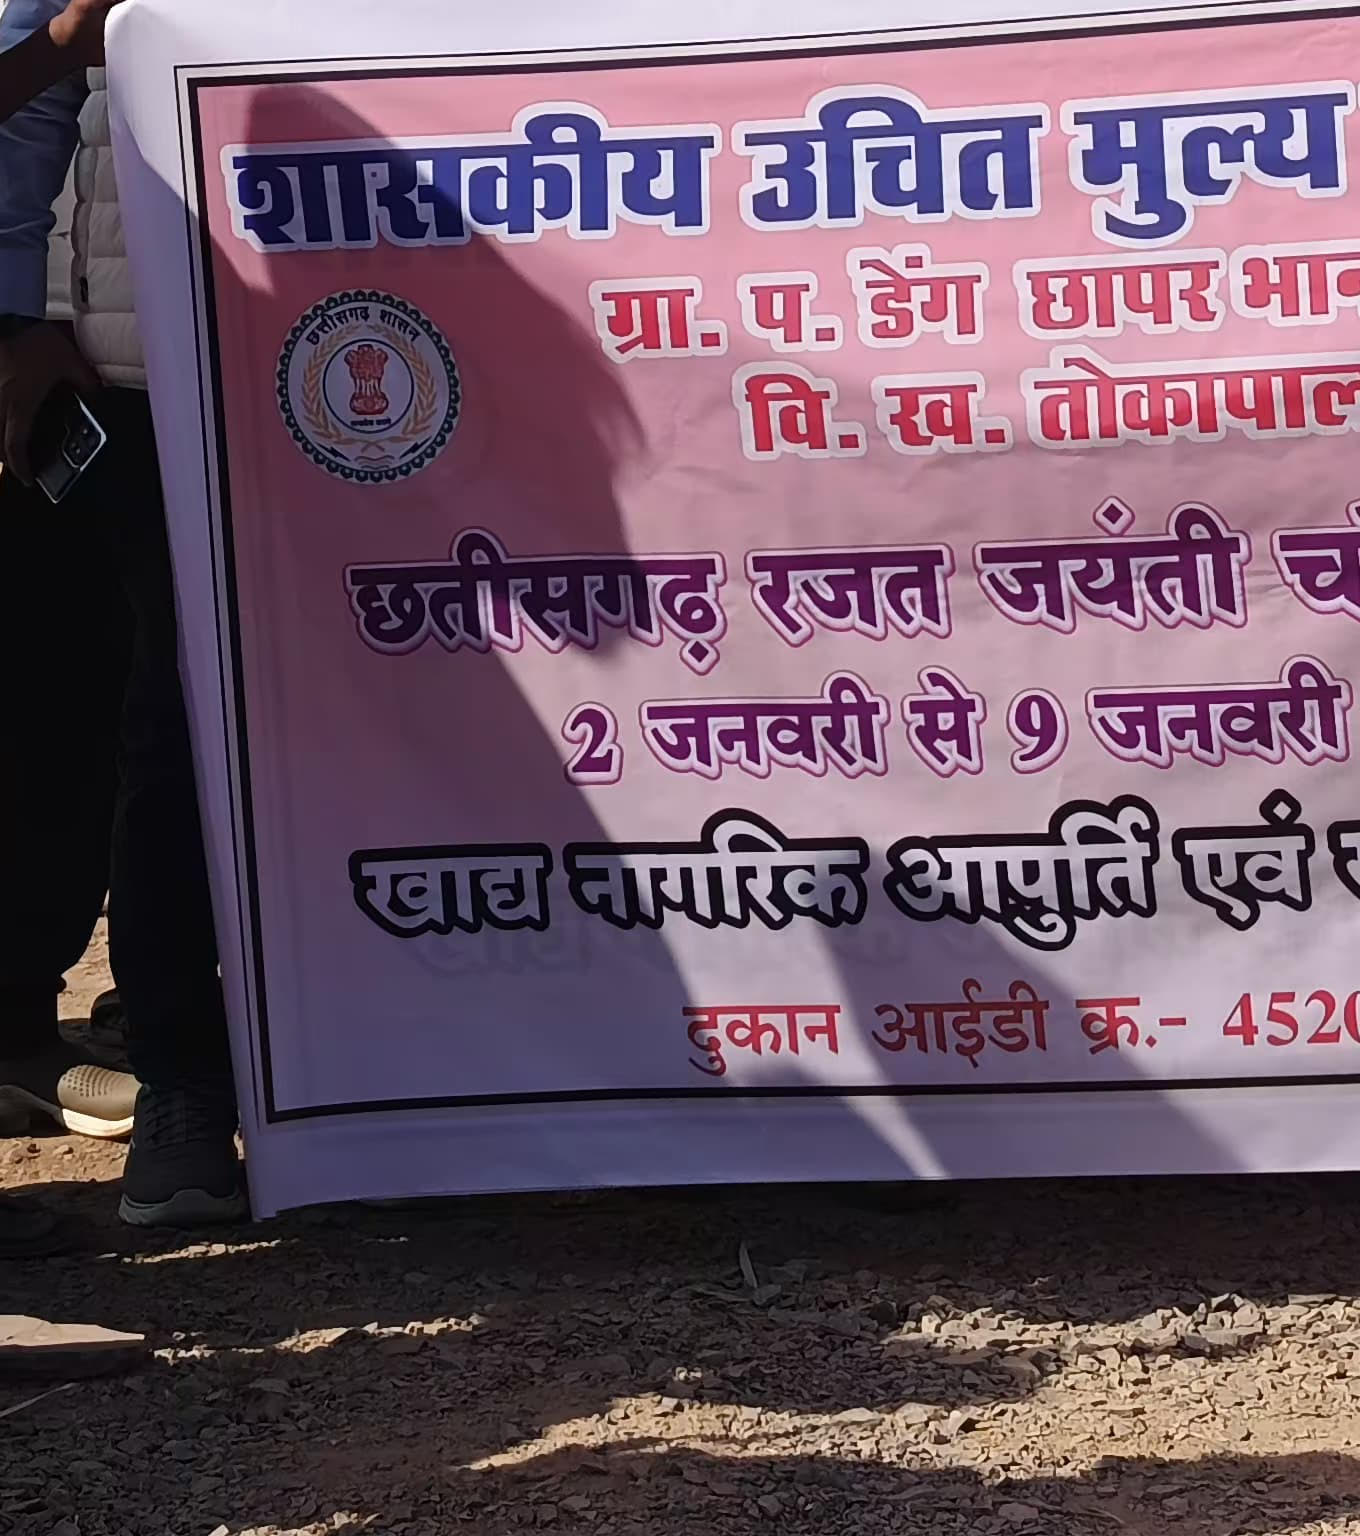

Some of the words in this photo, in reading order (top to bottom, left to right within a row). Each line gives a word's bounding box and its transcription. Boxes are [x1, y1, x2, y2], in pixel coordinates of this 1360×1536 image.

[232, 112, 714, 245] शासकीय
[744, 96, 1043, 221] उचित
[1073, 92, 1348, 240] मुल्य
[380, 308, 422, 343] शासन
[601, 287, 722, 354] ग्रा.
[749, 282, 837, 345] प.
[859, 255, 982, 339] डेंग
[745, 373, 861, 453] वि.
[884, 382, 1007, 447] ख.
[753, 547, 944, 636] रजत
[980, 499, 1240, 623] जयंती
[569, 710, 617, 773] 2
[647, 678, 880, 767] जनवरी
[911, 673, 977, 763] से
[1016, 694, 1059, 762] 9
[1093, 663, 1342, 755] जनवरी
[350, 843, 552, 938] खाद्य
[563, 808, 869, 930] नागरिक
[1172, 788, 1315, 930] एवं
[682, 1004, 840, 1073] दुकान
[872, 978, 1049, 1068] आईडी
